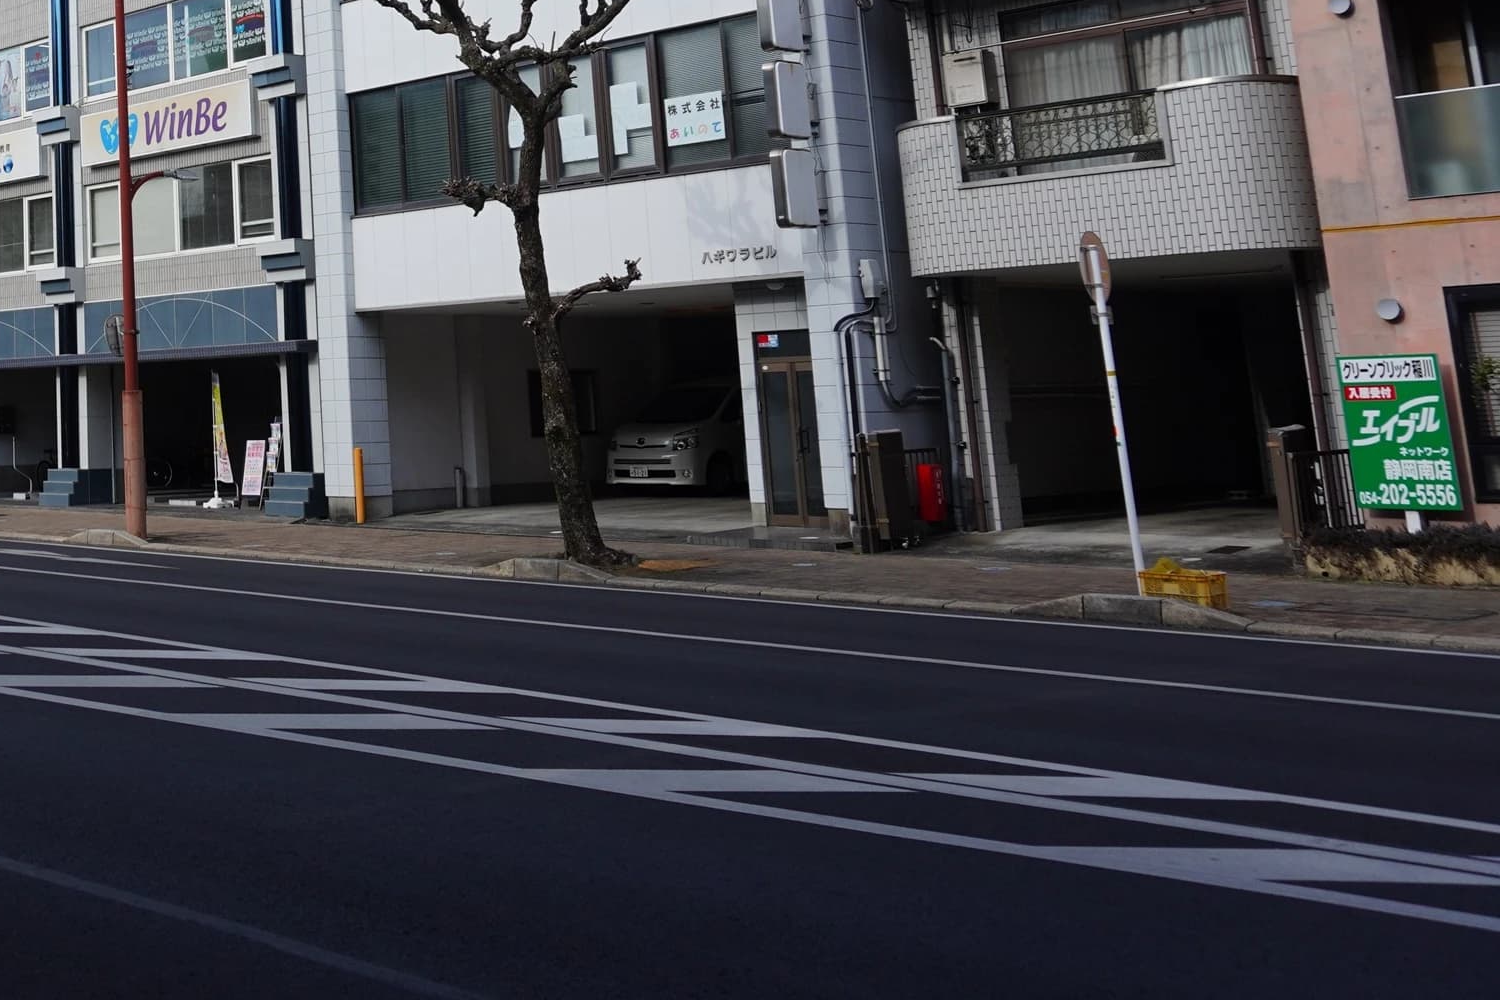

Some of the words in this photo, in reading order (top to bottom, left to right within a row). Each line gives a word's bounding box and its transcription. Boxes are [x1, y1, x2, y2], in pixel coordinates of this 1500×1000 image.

[667, 98, 721, 116] 株式会社
[144, 97, 228, 146] WinBe
[669, 121, 723, 140] あいのて
[701, 245, 777, 265] ハギワラビル
[1357, 402, 1441, 445] エイブル
[1399, 446, 1449, 457] ネットワーク
[1383, 459, 1453, 481] 静岡南店
[1359, 483, 1457, 506] 054-202-5556
